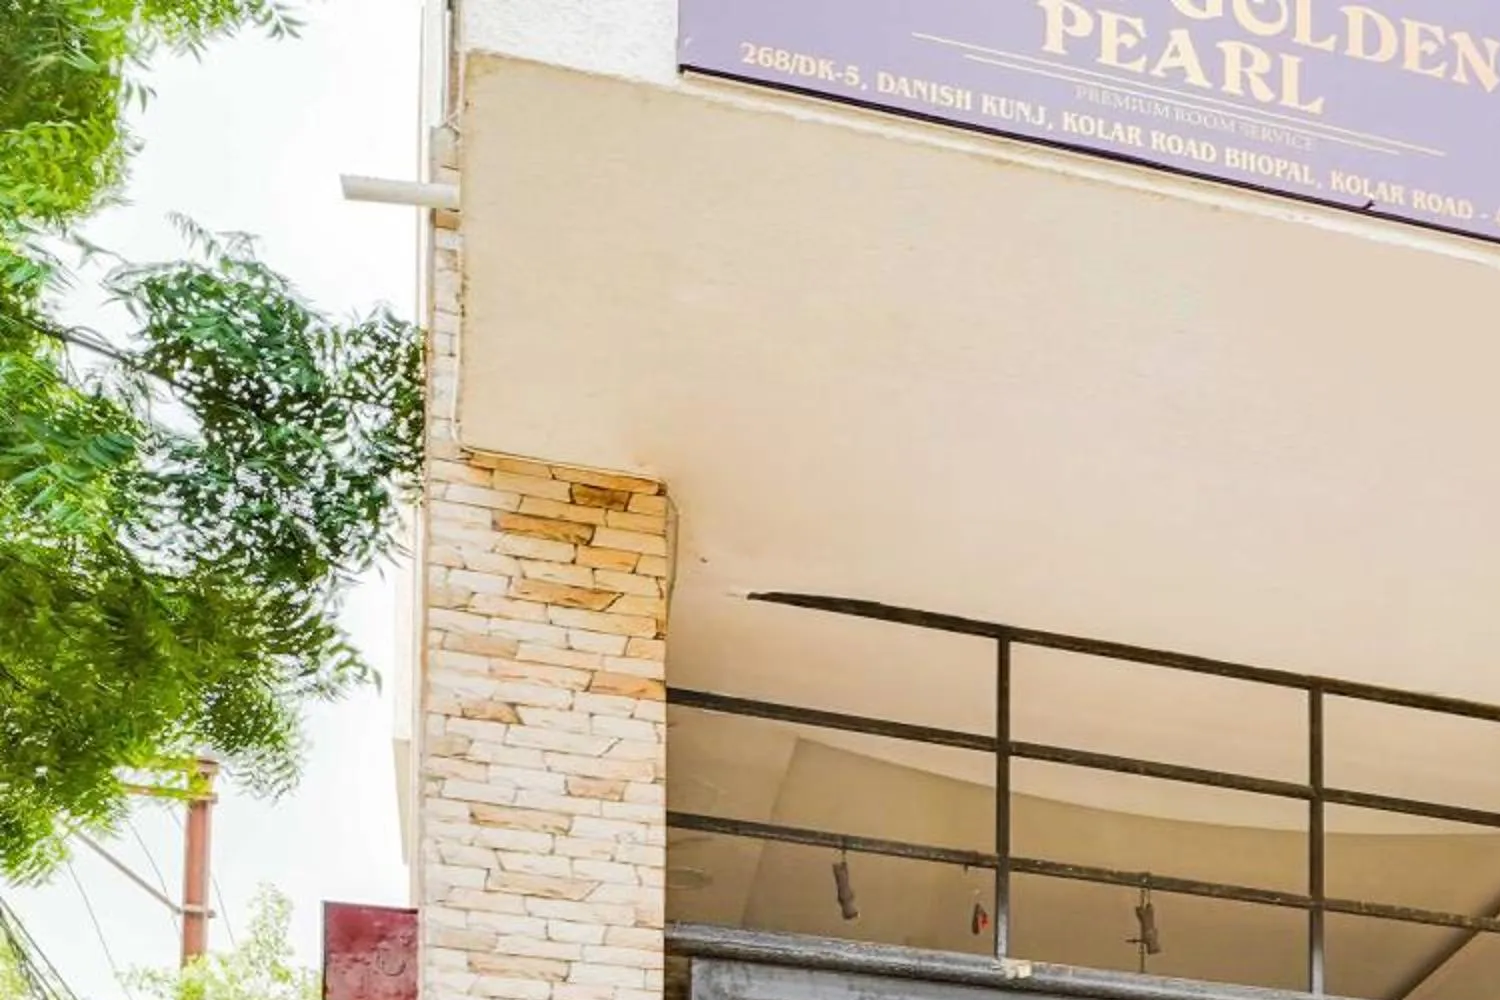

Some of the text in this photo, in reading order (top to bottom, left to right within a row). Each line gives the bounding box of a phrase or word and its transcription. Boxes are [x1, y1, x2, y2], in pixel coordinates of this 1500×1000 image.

[1036, 0, 1325, 115] PEARL
[740, 41, 869, 91] 268/DK-5,
[877, 71, 972, 111] DANISH
[981, 93, 1054, 130] KUNJ,
[1062, 111, 1143, 147] KOLAR
[1150, 129, 1218, 164] ROAD
[1224, 147, 1323, 190] BHOPAL,
[1331, 169, 1406, 205] KOLAR
[1413, 188, 1474, 220] ROAD
[1075, 84, 1318, 150] PREMIUM ROOM SERVICE
